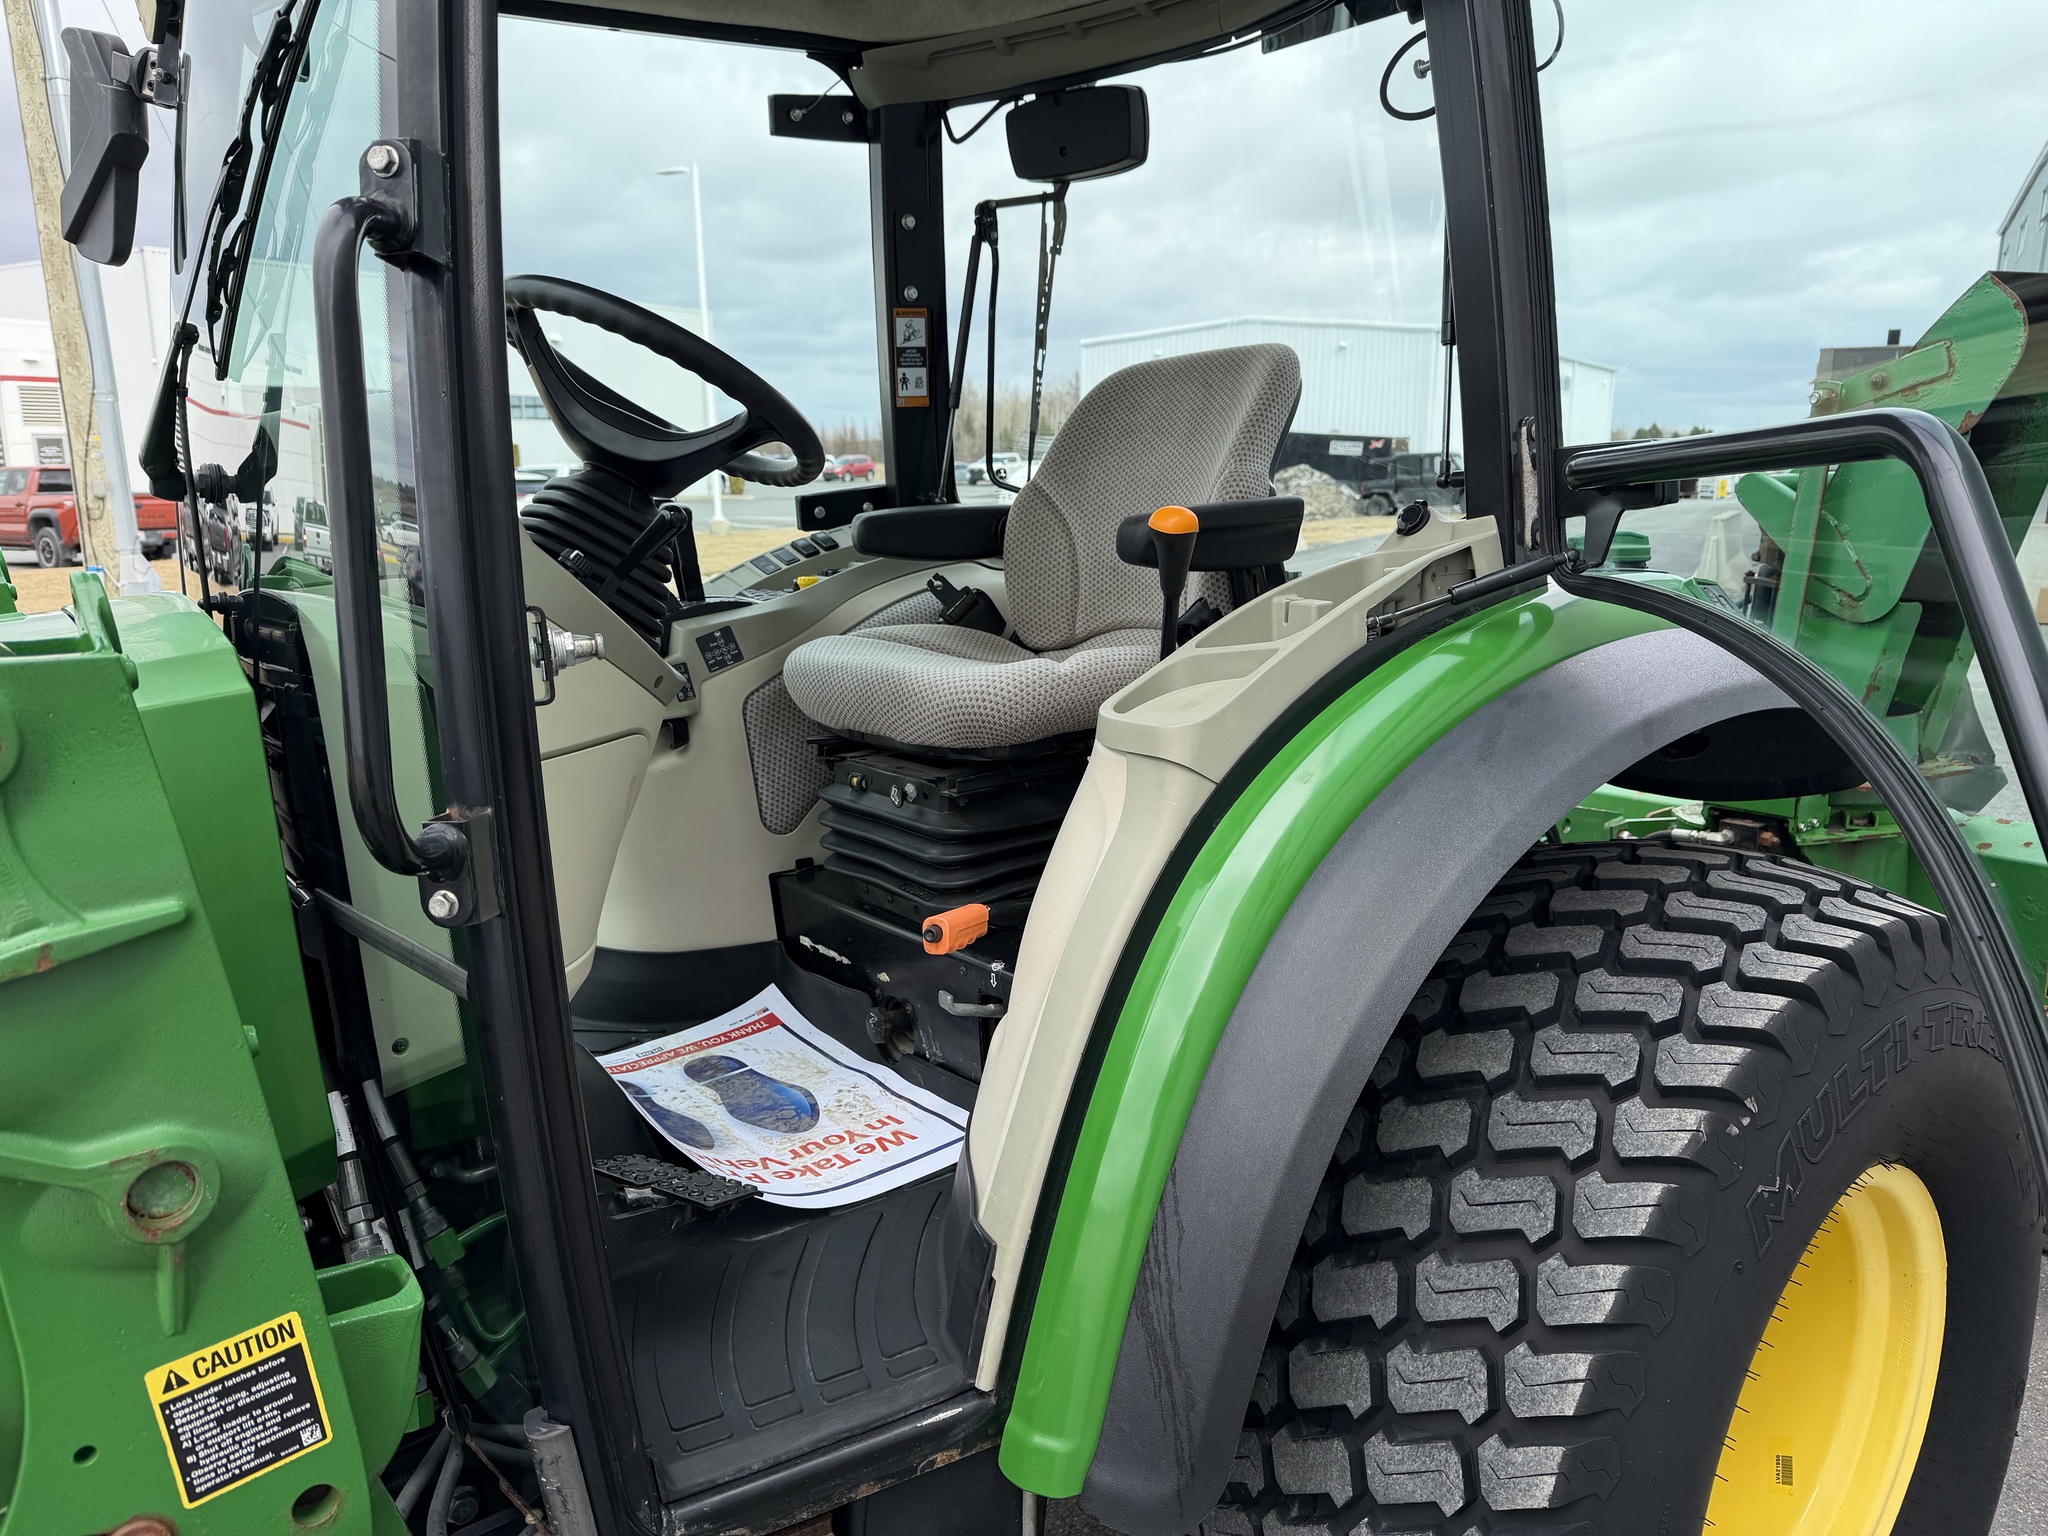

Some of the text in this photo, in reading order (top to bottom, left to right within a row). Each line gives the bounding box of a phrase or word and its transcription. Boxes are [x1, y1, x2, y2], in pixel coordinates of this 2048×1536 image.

[677, 1045, 699, 1055] WE
[727, 1020, 770, 1038] THANK
[854, 1130, 918, 1155] We
[864, 1115, 904, 1132] In
[1745, 1014, 1912, 1261] MULTI
[772, 1152, 861, 1181] Take
[787, 1129, 871, 1162] Your
[192, 1319, 296, 1378] CAUTION
[169, 1355, 285, 1411] Lock loader latches before
[174, 1370, 290, 1426] Before servicing, adjusting
[176, 1375, 297, 1434] equipment or disconnecting
[171, 1393, 218, 1419] operating.
[181, 1393, 293, 1449] A) Lower loader to ground
[178, 1419, 216, 1441] oil lines:
[185, 1401, 310, 1464] B) Shut off engine and relieve
[190, 1416, 314, 1478] Observe safety recommenda-
[194, 1408, 280, 1451] or support lift arms.
[198, 1424, 281, 1467] hydraulic pressure.
[192, 1452, 255, 1486] tions in loader
[194, 1450, 275, 1494] operator's manual.
